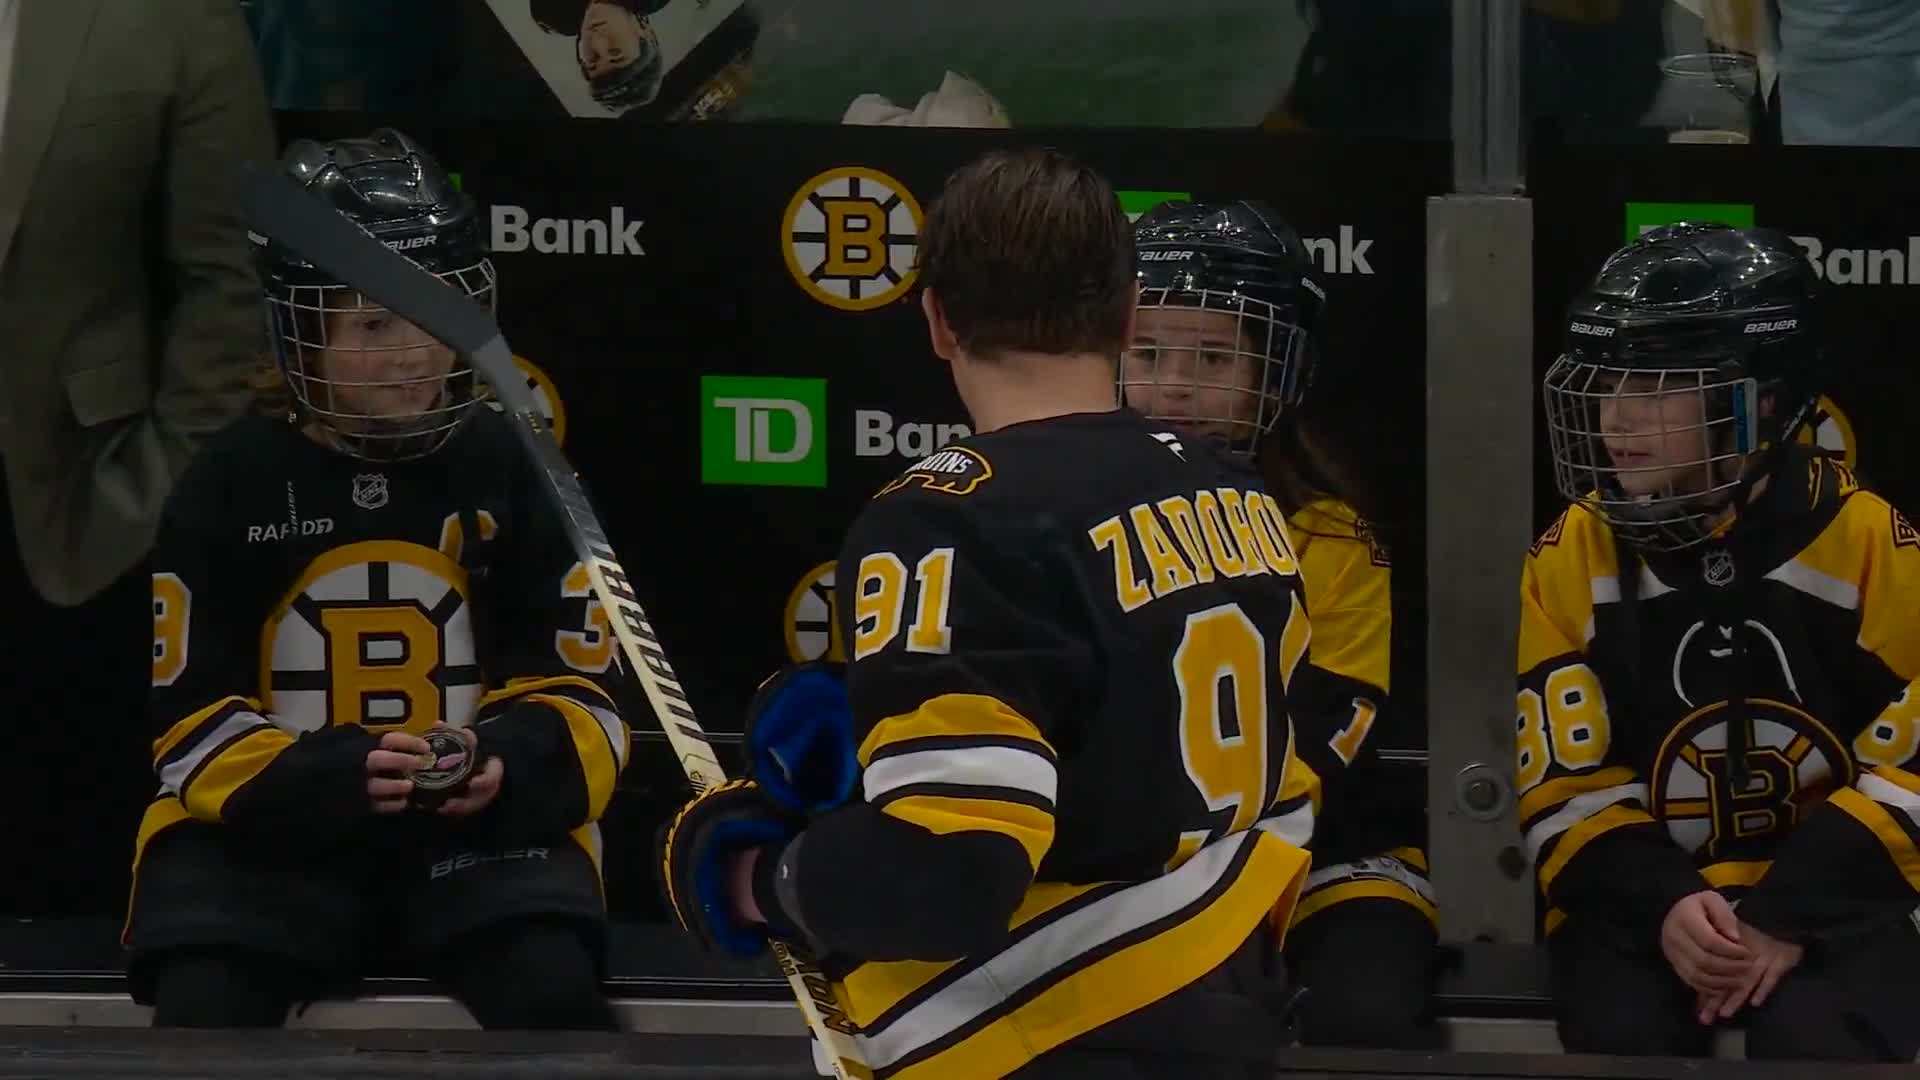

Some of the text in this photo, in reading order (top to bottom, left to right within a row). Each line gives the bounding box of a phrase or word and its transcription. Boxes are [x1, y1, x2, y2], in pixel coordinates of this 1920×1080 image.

[383, 234, 438, 251] AUER
[489, 204, 645, 256] Bank
[822, 197, 888, 280] B
[1139, 250, 1195, 262] AUER
[1302, 224, 1375, 276] nk
[1570, 320, 1616, 338] BAUER
[1743, 318, 1798, 335] BAUER
[712, 396, 973, 463] TD Ban
[904, 450, 975, 474] UINS
[1088, 487, 1299, 614] ZADORO
[853, 546, 956, 662] 91
[320, 604, 442, 736] B
